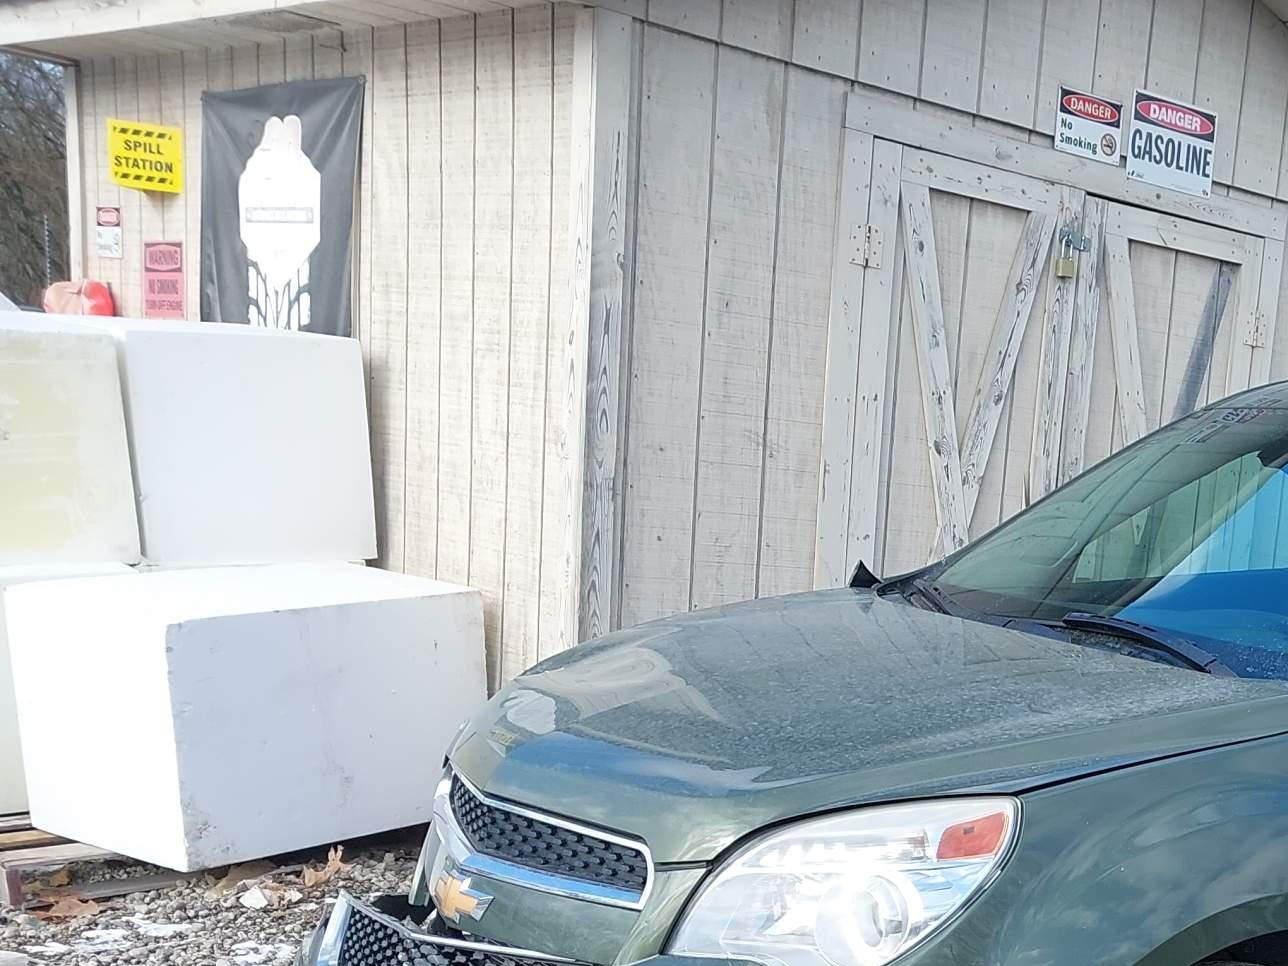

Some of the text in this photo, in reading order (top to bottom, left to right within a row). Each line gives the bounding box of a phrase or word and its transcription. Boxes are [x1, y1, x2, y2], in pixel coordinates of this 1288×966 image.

[1070, 97, 1111, 119] DANGER
[1149, 104, 1201, 131] DANGER
[1061, 118, 1073, 130] No
[123, 139, 164, 155] SPILL
[1060, 132, 1098, 155] Smoking
[1131, 128, 1212, 178] GASOLINE
[114, 155, 174, 173] STATION
